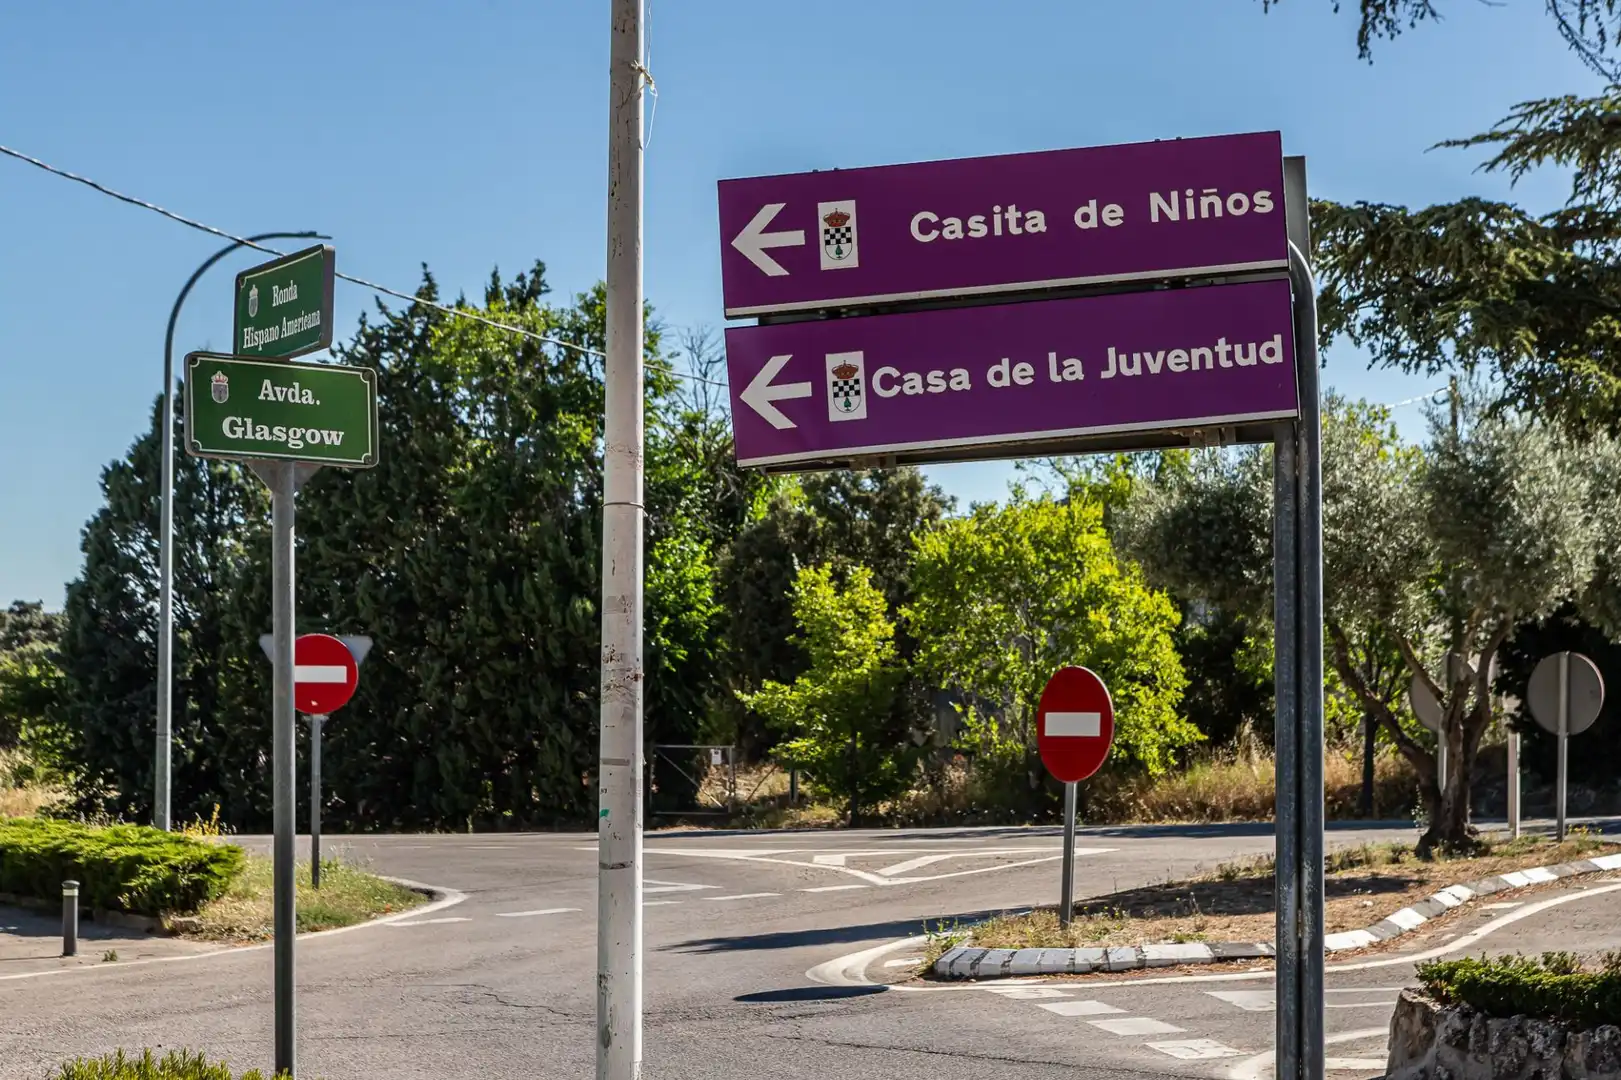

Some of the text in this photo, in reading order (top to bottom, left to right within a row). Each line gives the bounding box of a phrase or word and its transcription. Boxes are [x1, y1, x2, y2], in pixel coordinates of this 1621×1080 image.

[910, 188, 1273, 242] Casita de Niños
[272, 280, 298, 307] Ronda
[243, 309, 321, 351] Hispano Americana
[872, 334, 1283, 397] Casa de la Juventud
[258, 379, 321, 405] Avda.
[222, 416, 344, 448] Glasgow
